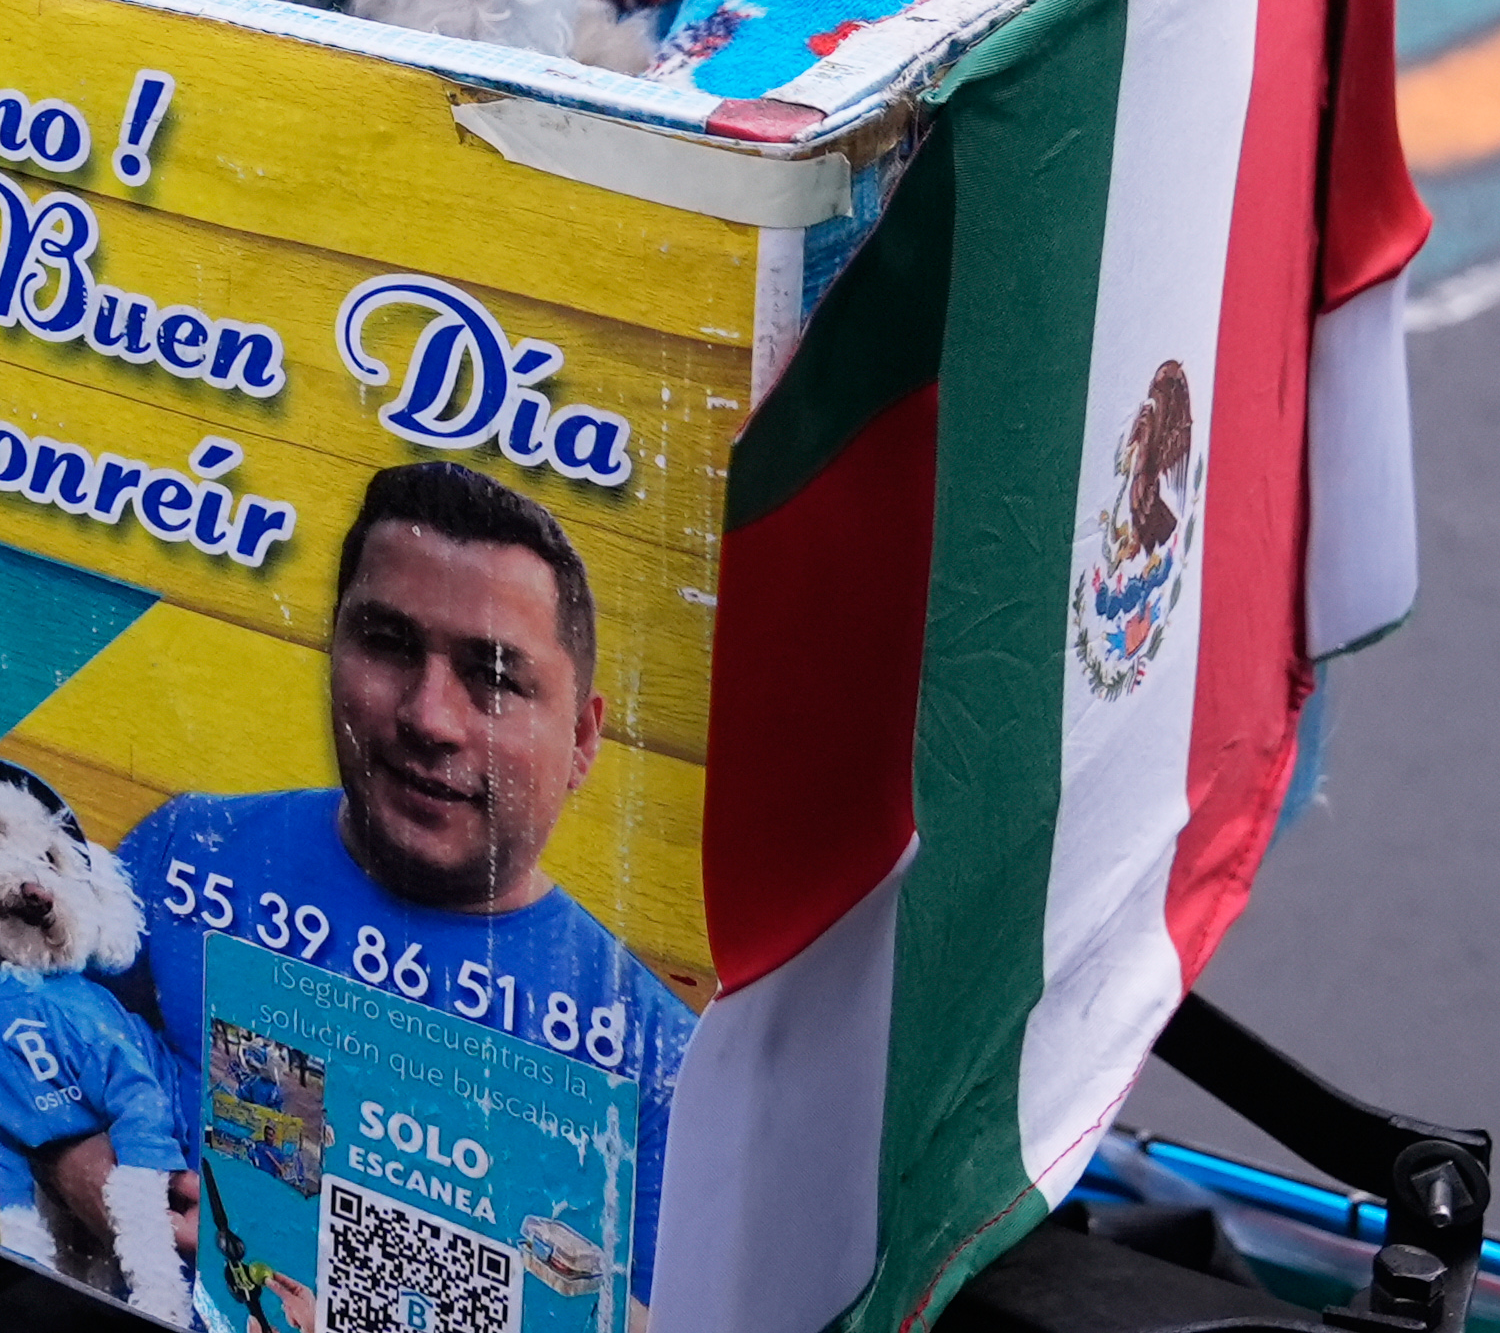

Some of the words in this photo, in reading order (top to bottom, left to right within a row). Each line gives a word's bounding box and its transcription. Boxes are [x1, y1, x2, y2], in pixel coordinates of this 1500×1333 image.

[118, 76, 168, 178] !
[341, 280, 628, 480] Día
[163, 858, 236, 929] 55
[255, 891, 331, 961] 39
[352, 924, 430, 999] 86
[453, 958, 516, 1033] 51
[541, 990, 628, 1068] 88
[259, 1004, 380, 1064] solución
[389, 1051, 445, 1081] que
[388, 1008, 554, 1085] encuentras
[35, 1085, 83, 1111] OSITO
[359, 1100, 490, 1179] SOLO
[347, 1143, 497, 1225] ESCANEA
